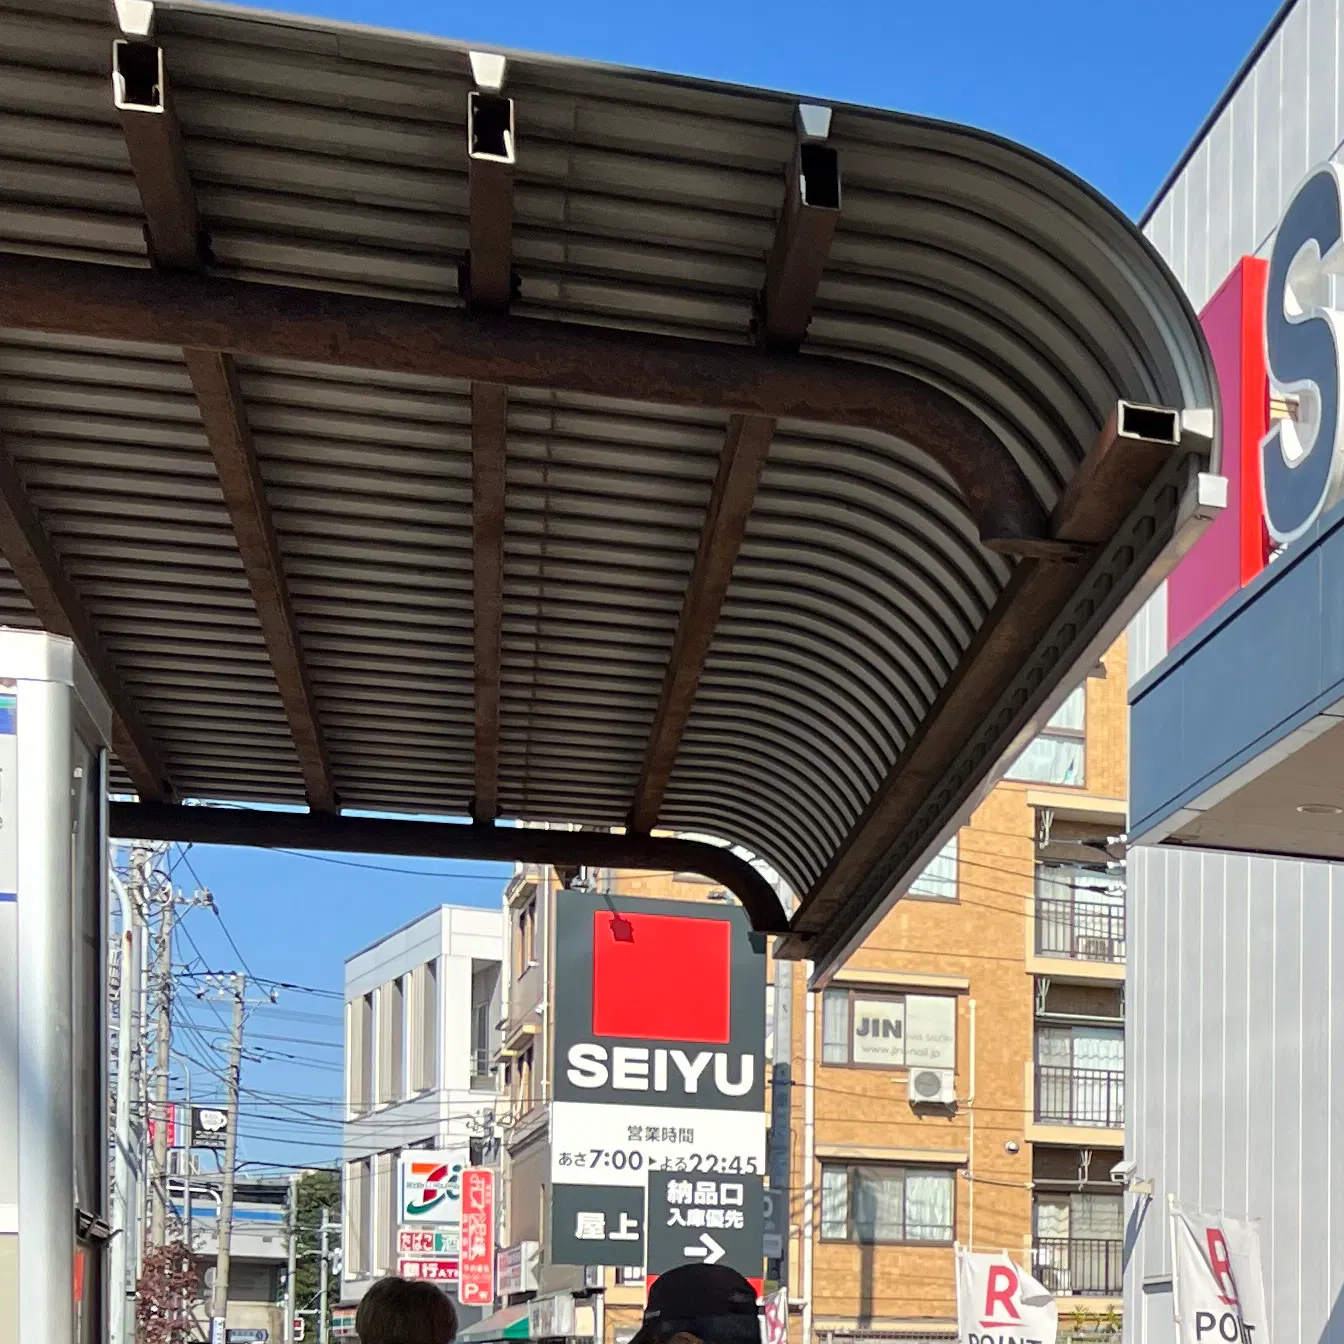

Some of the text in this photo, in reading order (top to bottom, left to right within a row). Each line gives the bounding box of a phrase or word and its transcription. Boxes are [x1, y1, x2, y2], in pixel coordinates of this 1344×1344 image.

[856, 1017, 902, 1039] JIN
[566, 1043, 754, 1096] SEIYU
[627, 1125, 695, 1145] 営業時間
[667, 1179, 744, 1206] 納品口
[575, 1212, 640, 1241] 屋上
[667, 1207, 744, 1229] 入庫優先
[401, 1232, 433, 1251] たばこ
[985, 1264, 1022, 1320] R
